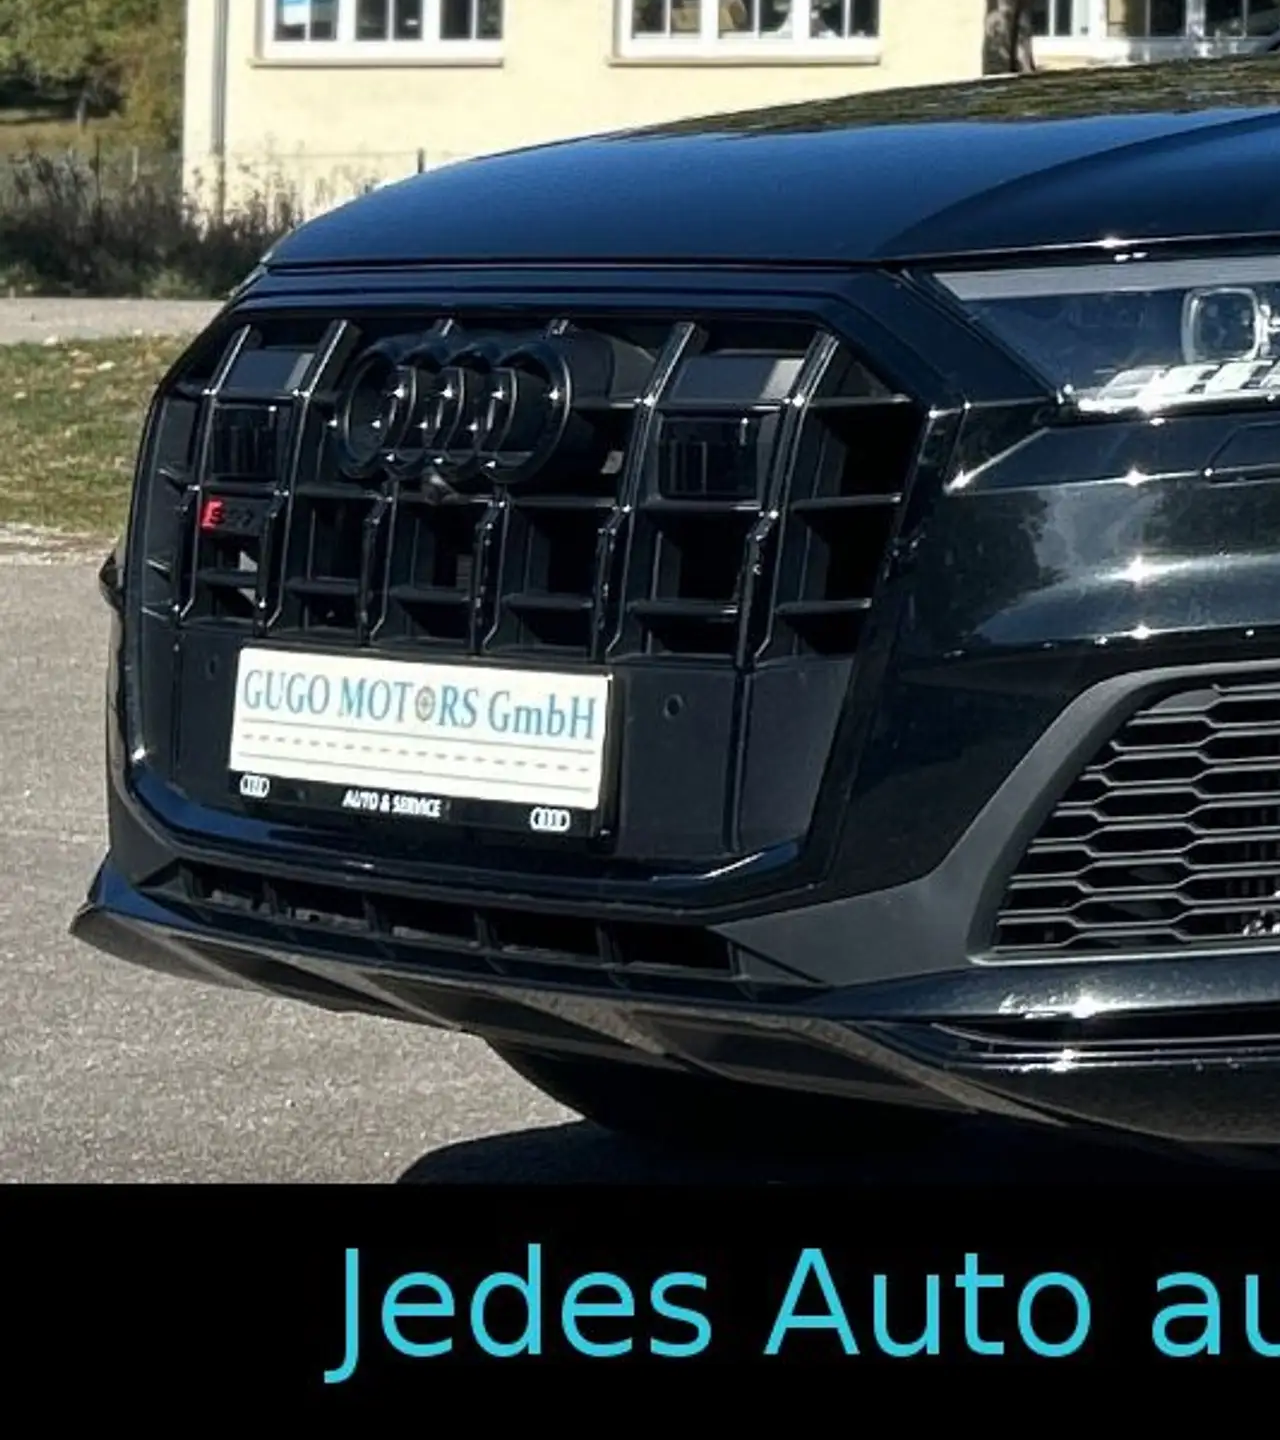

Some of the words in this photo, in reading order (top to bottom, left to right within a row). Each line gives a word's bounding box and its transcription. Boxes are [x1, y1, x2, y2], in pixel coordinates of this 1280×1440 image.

[243, 669, 331, 714] GUGO
[488, 691, 596, 740] GmbH
[342, 790, 379, 810] AUTO
[392, 794, 441, 818] SERVICE
